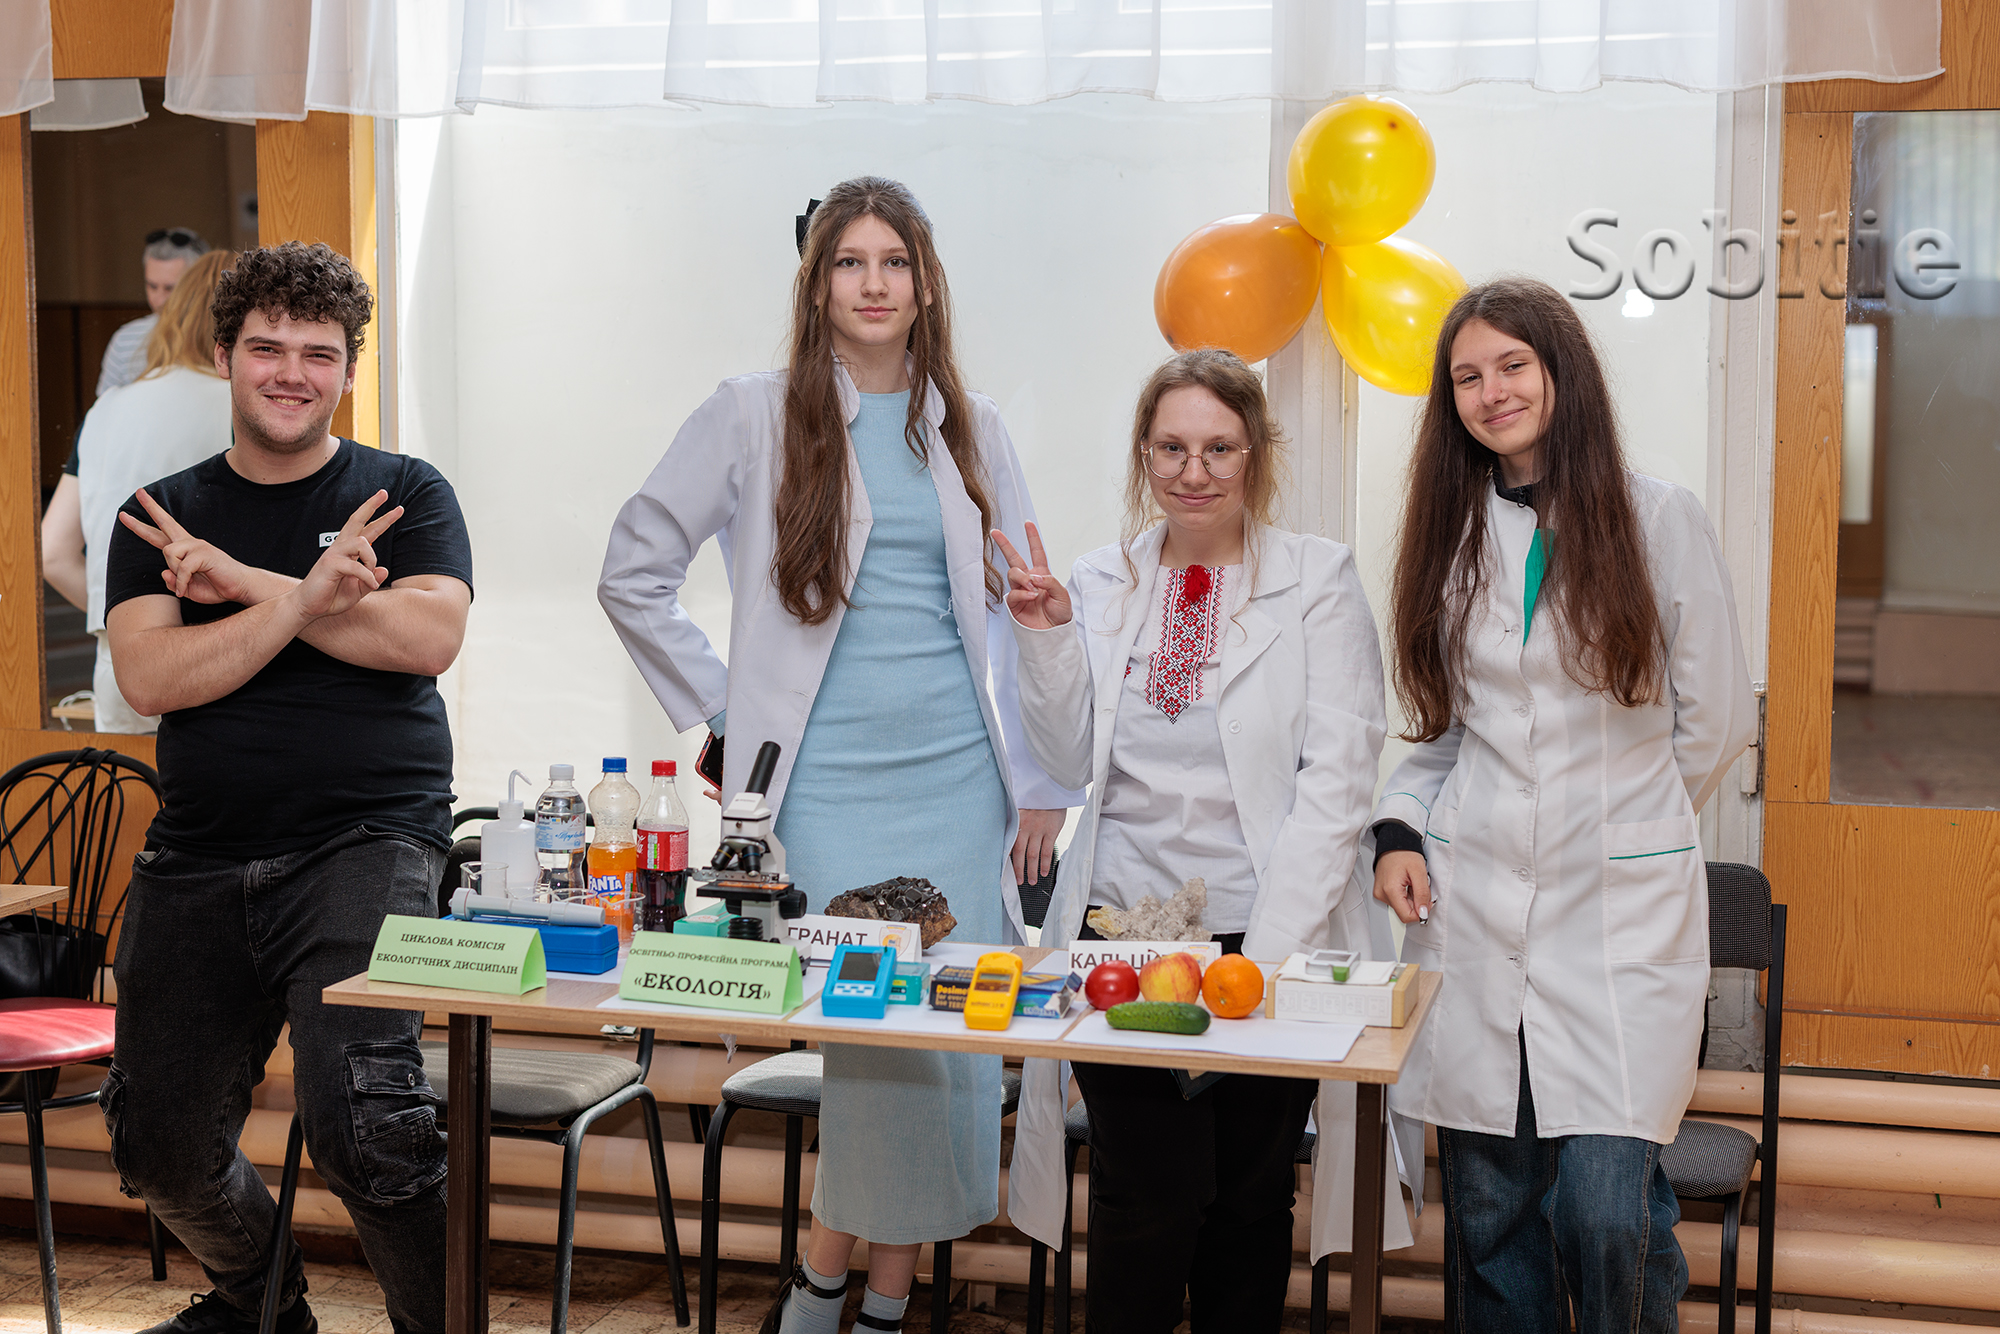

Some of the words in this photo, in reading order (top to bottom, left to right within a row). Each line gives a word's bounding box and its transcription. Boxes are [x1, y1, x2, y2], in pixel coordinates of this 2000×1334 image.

[588, 874, 623, 892] FANTA
[400, 933, 453, 946] ЦИКЛОВА
[456, 939, 506, 951] КОМІСІЯ
[788, 926, 868, 947] ГРАНАТ
[376, 953, 451, 968] ЕКОЛОГІЧНИХ
[453, 960, 518, 975] ДИСЦИПЛІН
[629, 948, 738, 965] ОСВІТНЬО-ПРОФЕСІЙНА
[740, 957, 790, 969] ПРОГРАМА
[1071, 952, 1166, 970] КАЛЦ
[634, 972, 771, 1000] «ЕКОЛОГІЯ»
[936, 984, 968, 995] Dosime
